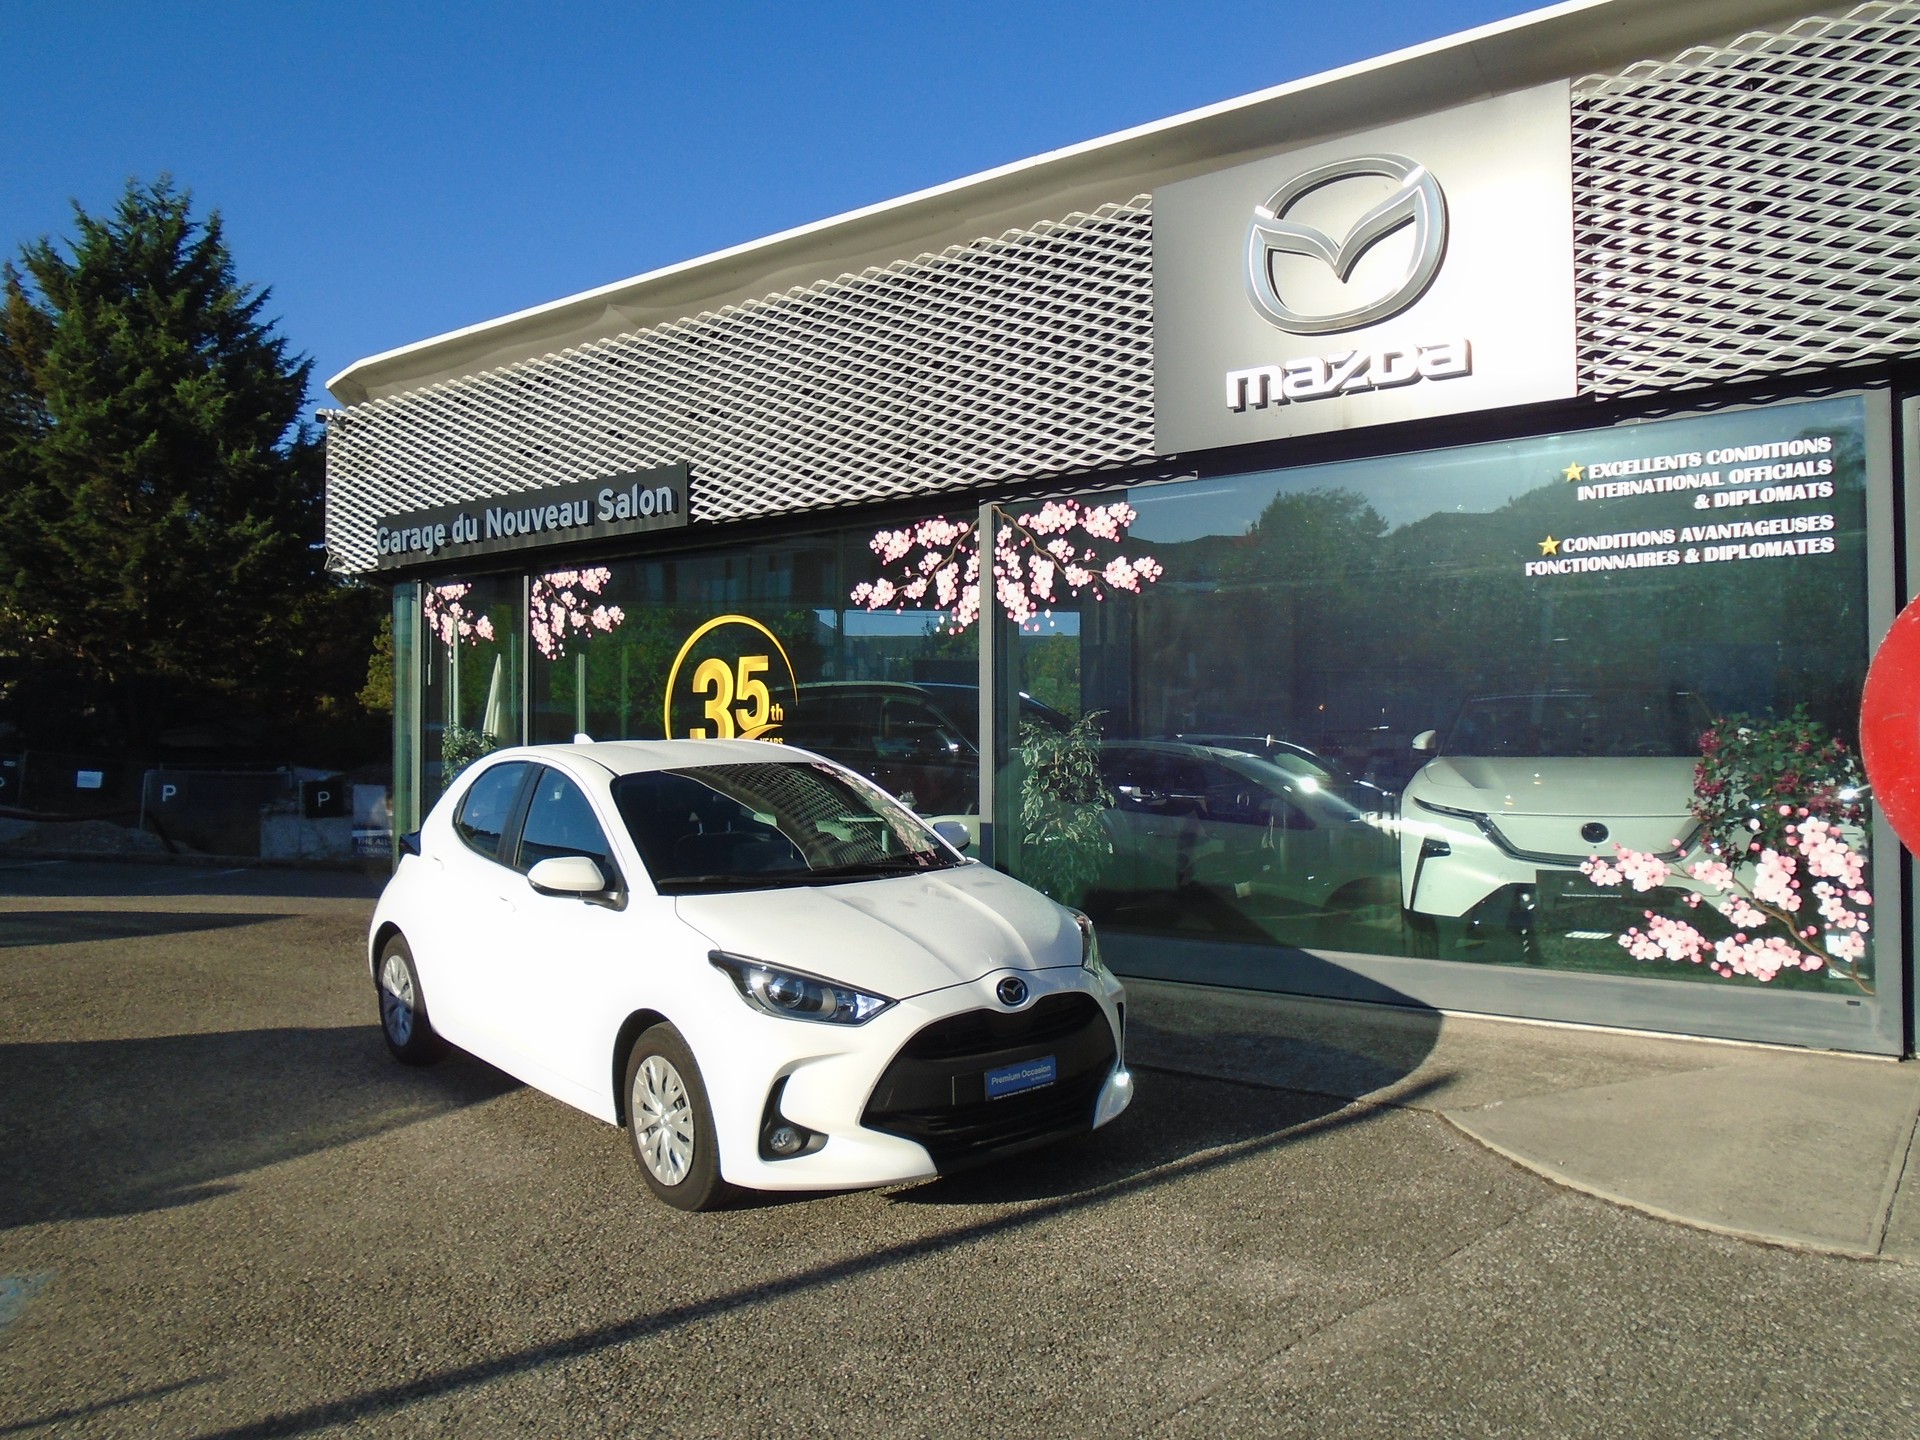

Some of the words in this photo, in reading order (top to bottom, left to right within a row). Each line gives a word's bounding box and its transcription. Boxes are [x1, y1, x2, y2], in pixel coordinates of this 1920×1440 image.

[1226, 337, 1473, 413] mazda
[1588, 452, 1702, 480] EXCELLENTS
[1706, 436, 1833, 465] CONDITIONS
[1577, 471, 1725, 501] INTERNATIONAL
[1728, 459, 1833, 484] OFFICIALS
[1694, 494, 1711, 510] &
[1714, 481, 1834, 508] DIPLOMATS
[377, 522, 446, 556] Garage
[452, 512, 479, 544] du
[485, 499, 590, 538] Nouveau
[597, 483, 673, 522] Salon
[1562, 528, 1677, 553] CONDITIONS
[1679, 514, 1835, 543] AVANTAGEUSES
[1525, 549, 1681, 577] FONCTIONNAIRES
[1684, 547, 1700, 564] &
[1704, 537, 1835, 563] DIPLOMATES
[161, 784, 177, 802] P
[317, 790, 330, 807] P
[991, 1072, 1020, 1085] Premium
[1021, 1064, 1051, 1079] Occasion
